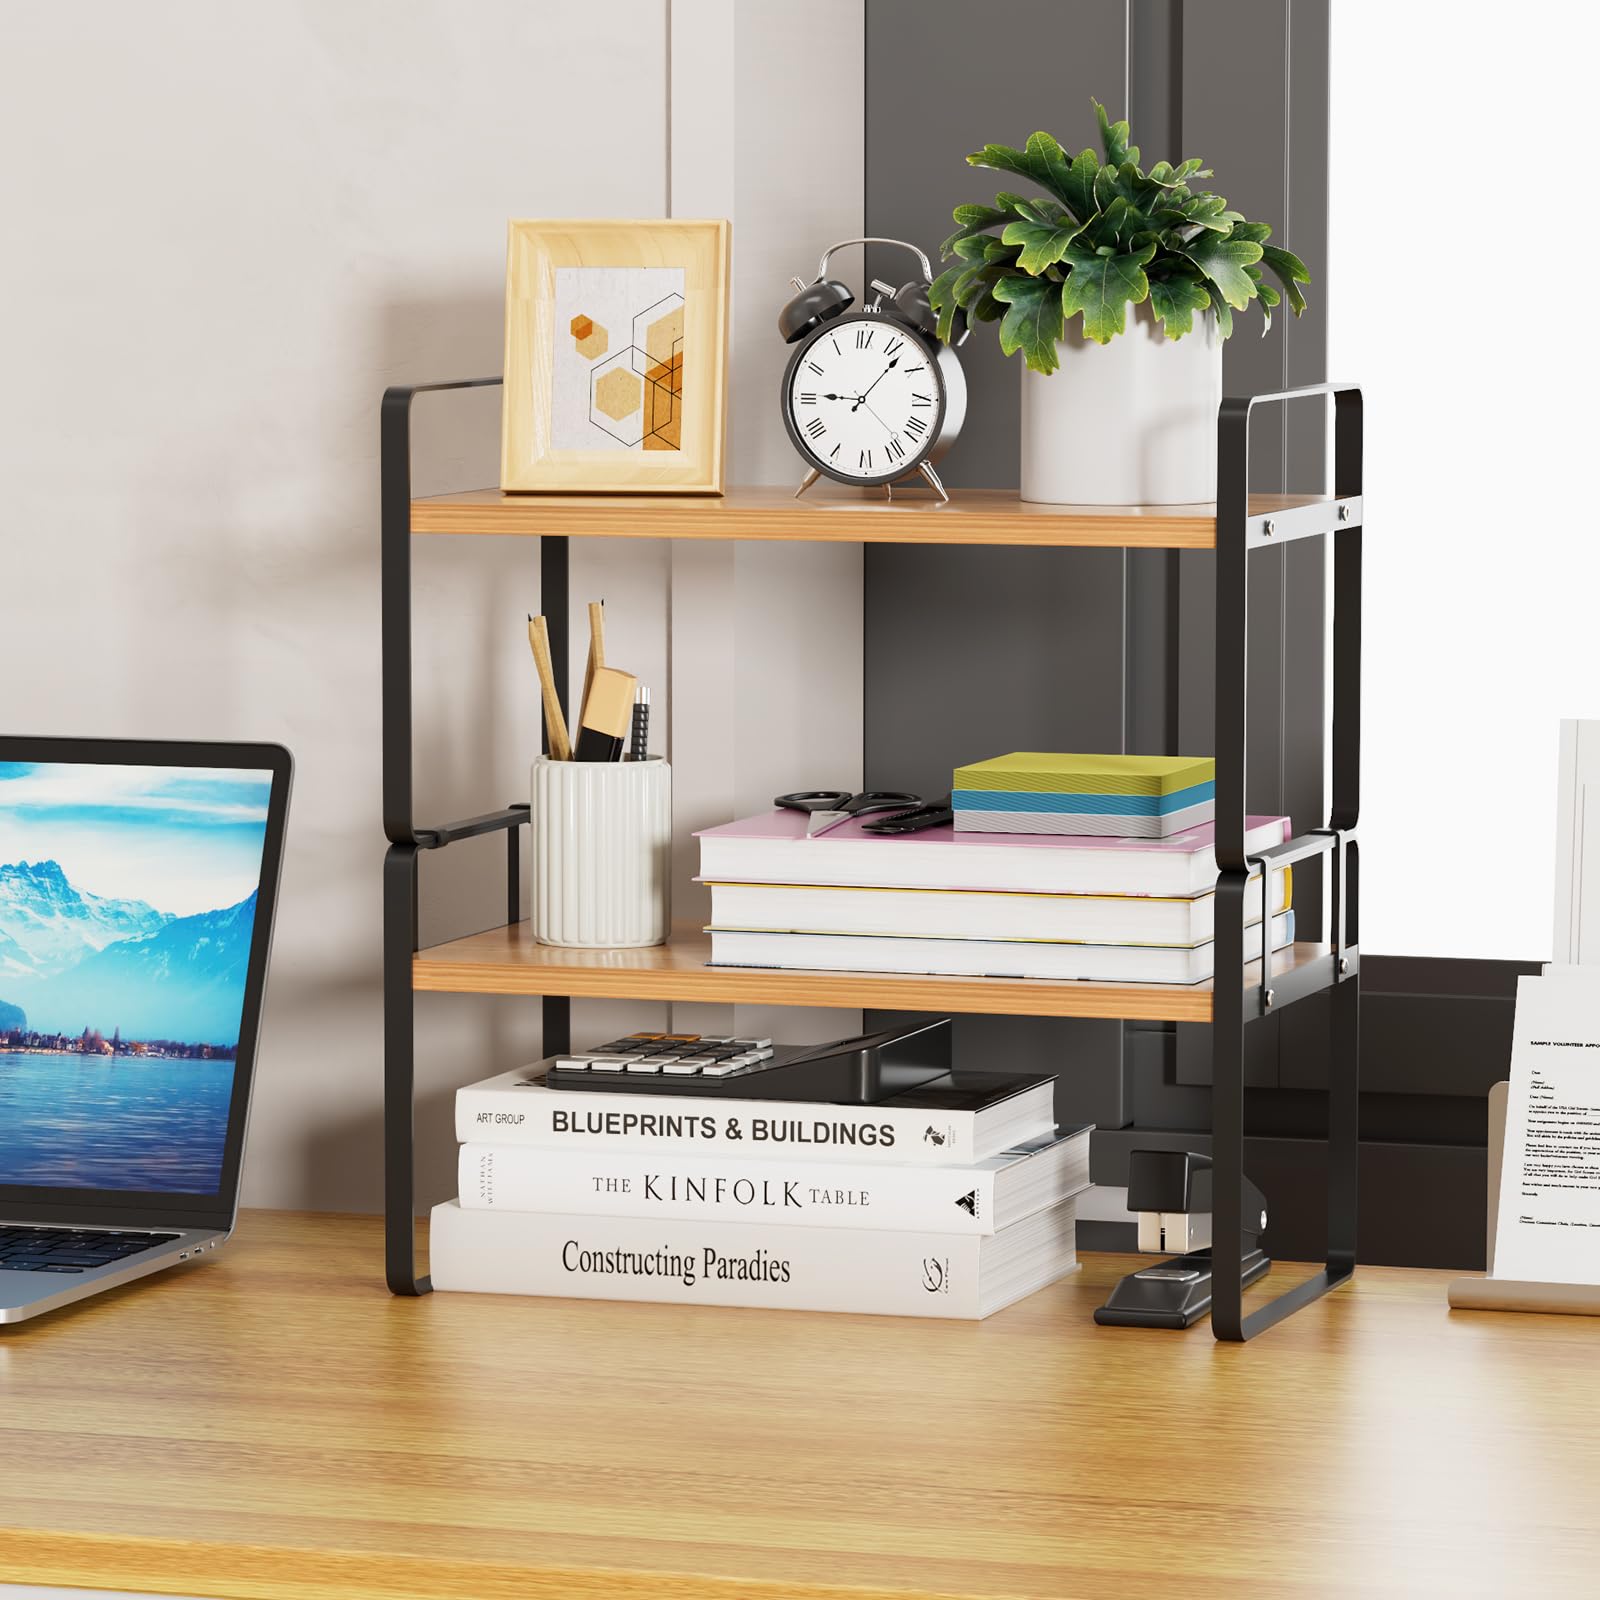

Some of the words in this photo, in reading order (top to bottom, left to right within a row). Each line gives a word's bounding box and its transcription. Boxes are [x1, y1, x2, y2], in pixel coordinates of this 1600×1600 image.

[477, 1112, 494, 1124] ART
[495, 1113, 526, 1125] GROUP
[552, 1110, 717, 1139] BLUEPRINTS
[725, 1117, 743, 1140] &
[752, 1119, 895, 1147] BUILDINGS
[592, 1177, 631, 1193] THE
[645, 1174, 803, 1208] KINFOLK
[808, 1188, 870, 1206] TABLE
[562, 1240, 696, 1287] Constructing
[703, 1247, 791, 1284] Paradies
